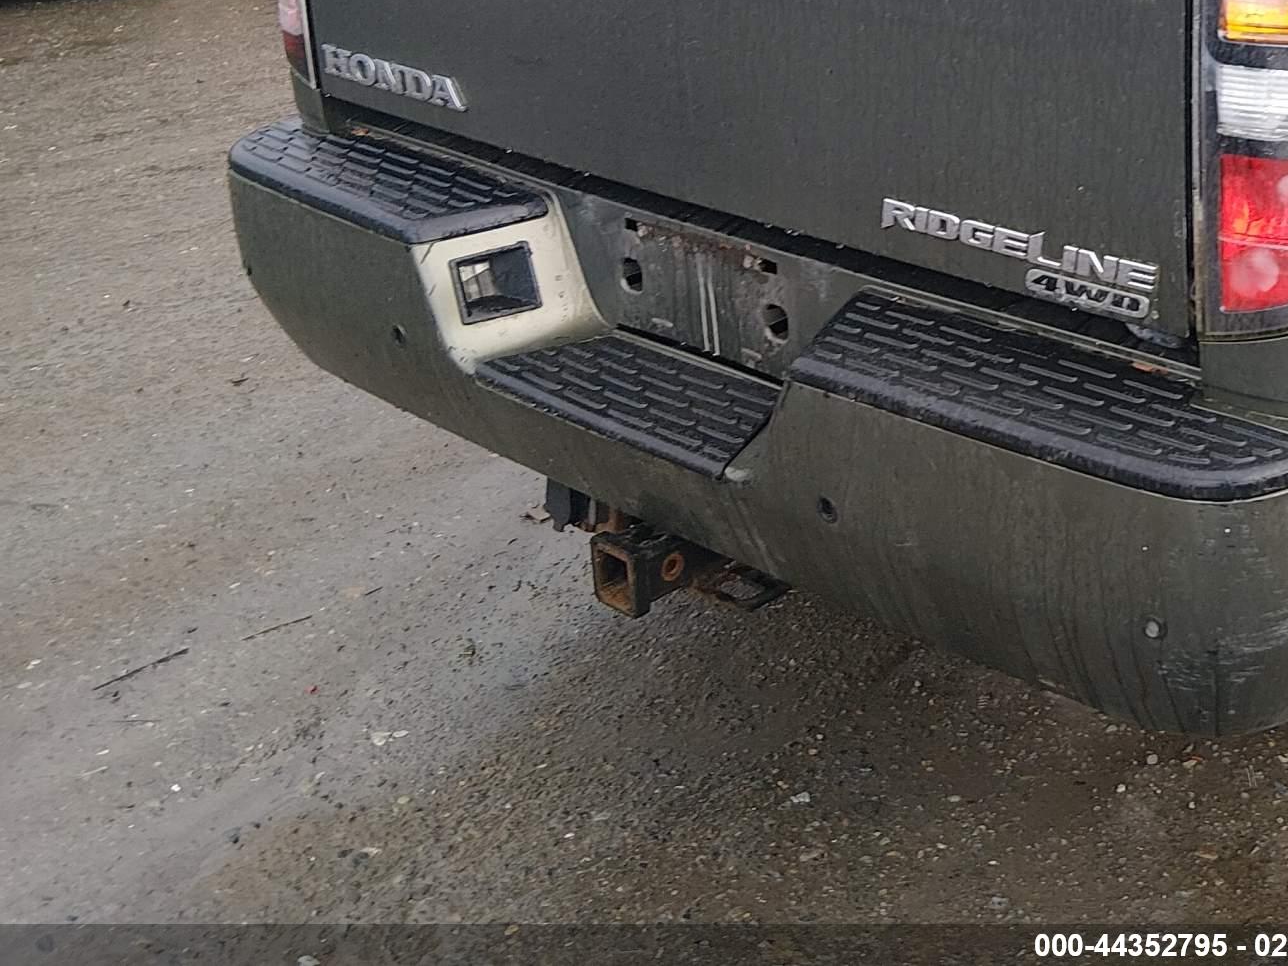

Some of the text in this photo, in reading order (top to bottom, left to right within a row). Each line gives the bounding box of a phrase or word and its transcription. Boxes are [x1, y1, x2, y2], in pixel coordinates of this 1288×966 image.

[321, 43, 468, 111] HONDA
[880, 197, 1159, 291] RIDGELINE
[1030, 274, 1143, 313] 4WD
